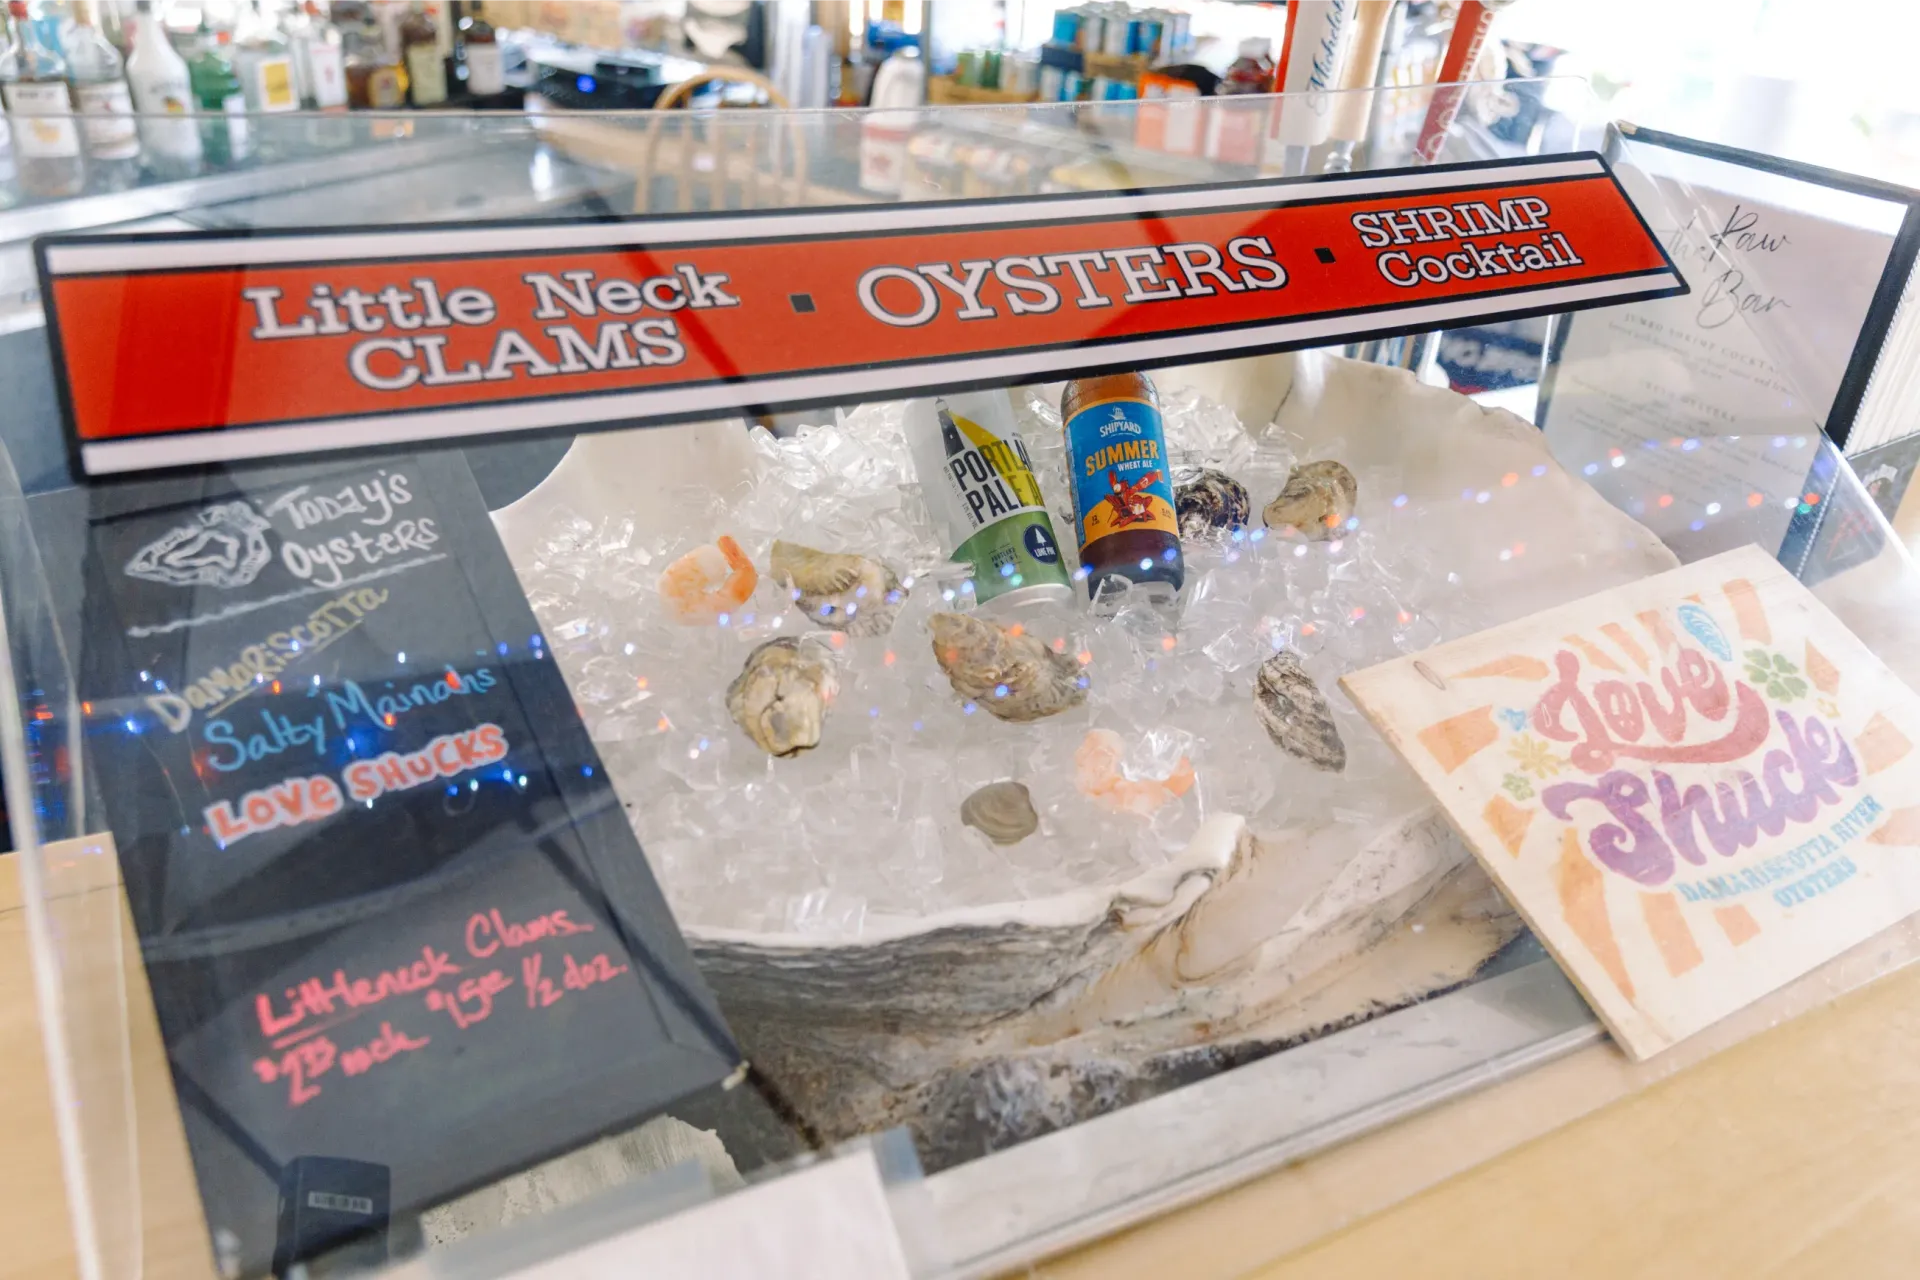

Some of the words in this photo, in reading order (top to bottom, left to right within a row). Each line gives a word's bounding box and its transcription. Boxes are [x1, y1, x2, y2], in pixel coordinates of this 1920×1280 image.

[1351, 196, 1551, 249] SHRIMP
[856, 235, 1289, 329] OYSTERS
[1377, 232, 1584, 288] Cocktail
[243, 277, 496, 340] Little
[523, 264, 740, 320] Neck
[1696, 268, 1792, 329] Bar
[348, 318, 685, 390] CLAMS
[1100, 420, 1142, 438] SHIPYARD
[1085, 439, 1160, 477] SUMMER
[1117, 461, 1141, 472] WHEAT
[1142, 460, 1153, 468] ALE
[1532, 648, 1770, 774] Love
[204, 708, 327, 772] Salty
[1541, 709, 1860, 887] Shuck
[1829, 794, 1885, 845] RIVER
[1772, 854, 1858, 908] OYSTERS
[465, 907, 594, 959] Clams
